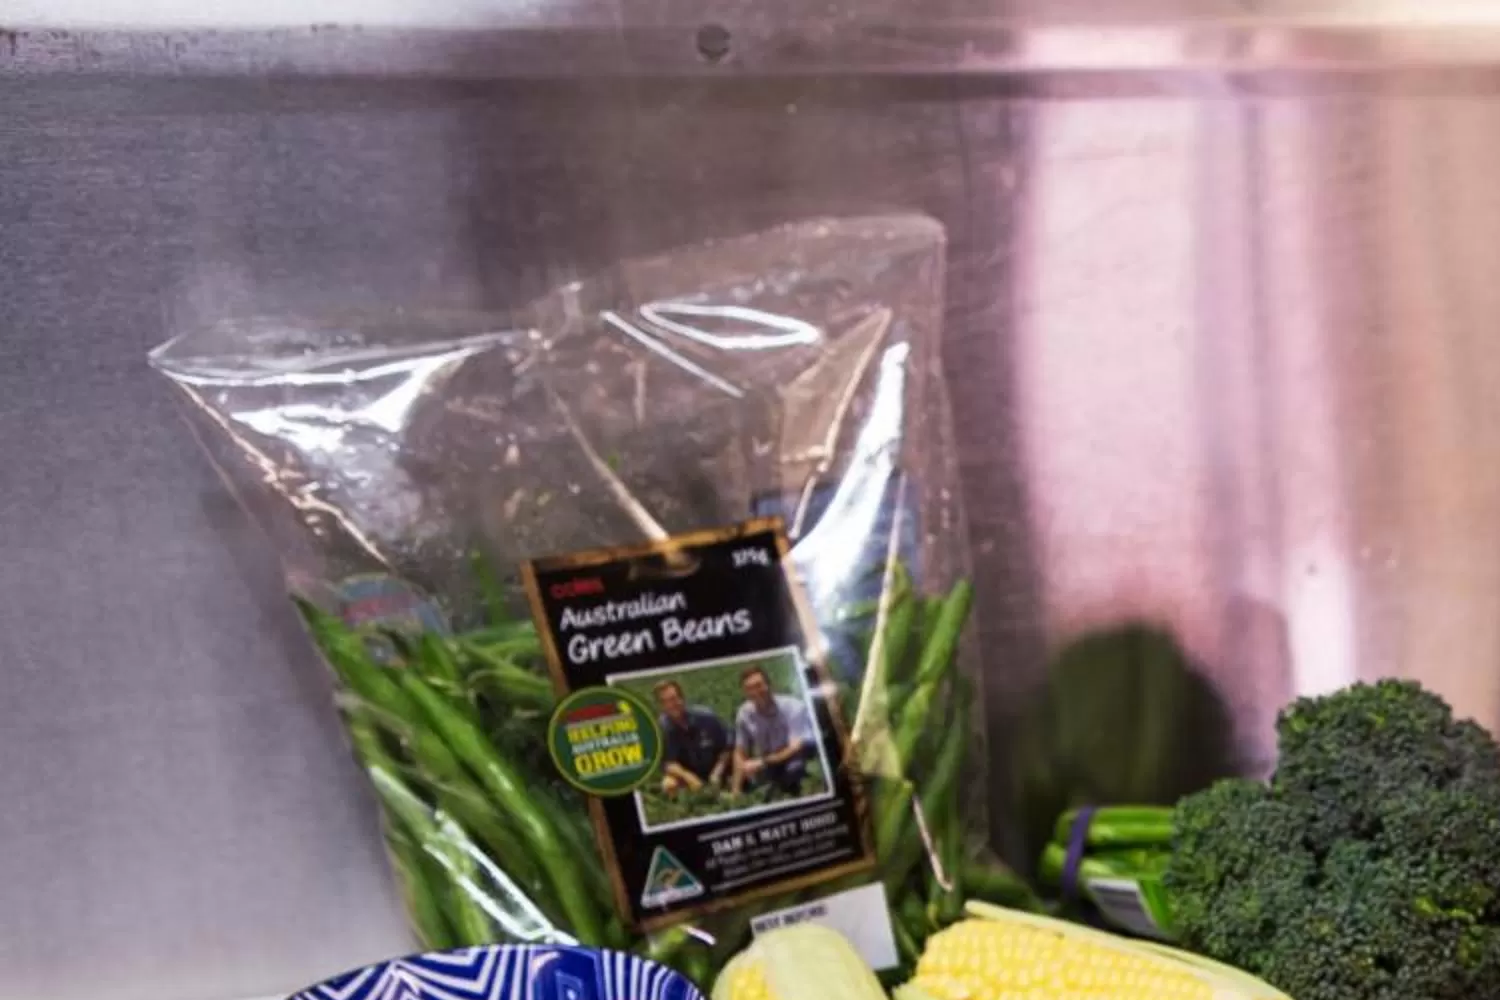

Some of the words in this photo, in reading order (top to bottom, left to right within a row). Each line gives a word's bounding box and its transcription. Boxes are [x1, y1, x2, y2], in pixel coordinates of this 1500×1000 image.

[559, 591, 687, 631] Australian
[567, 628, 656, 665] Green
[660, 608, 753, 648] Beans
